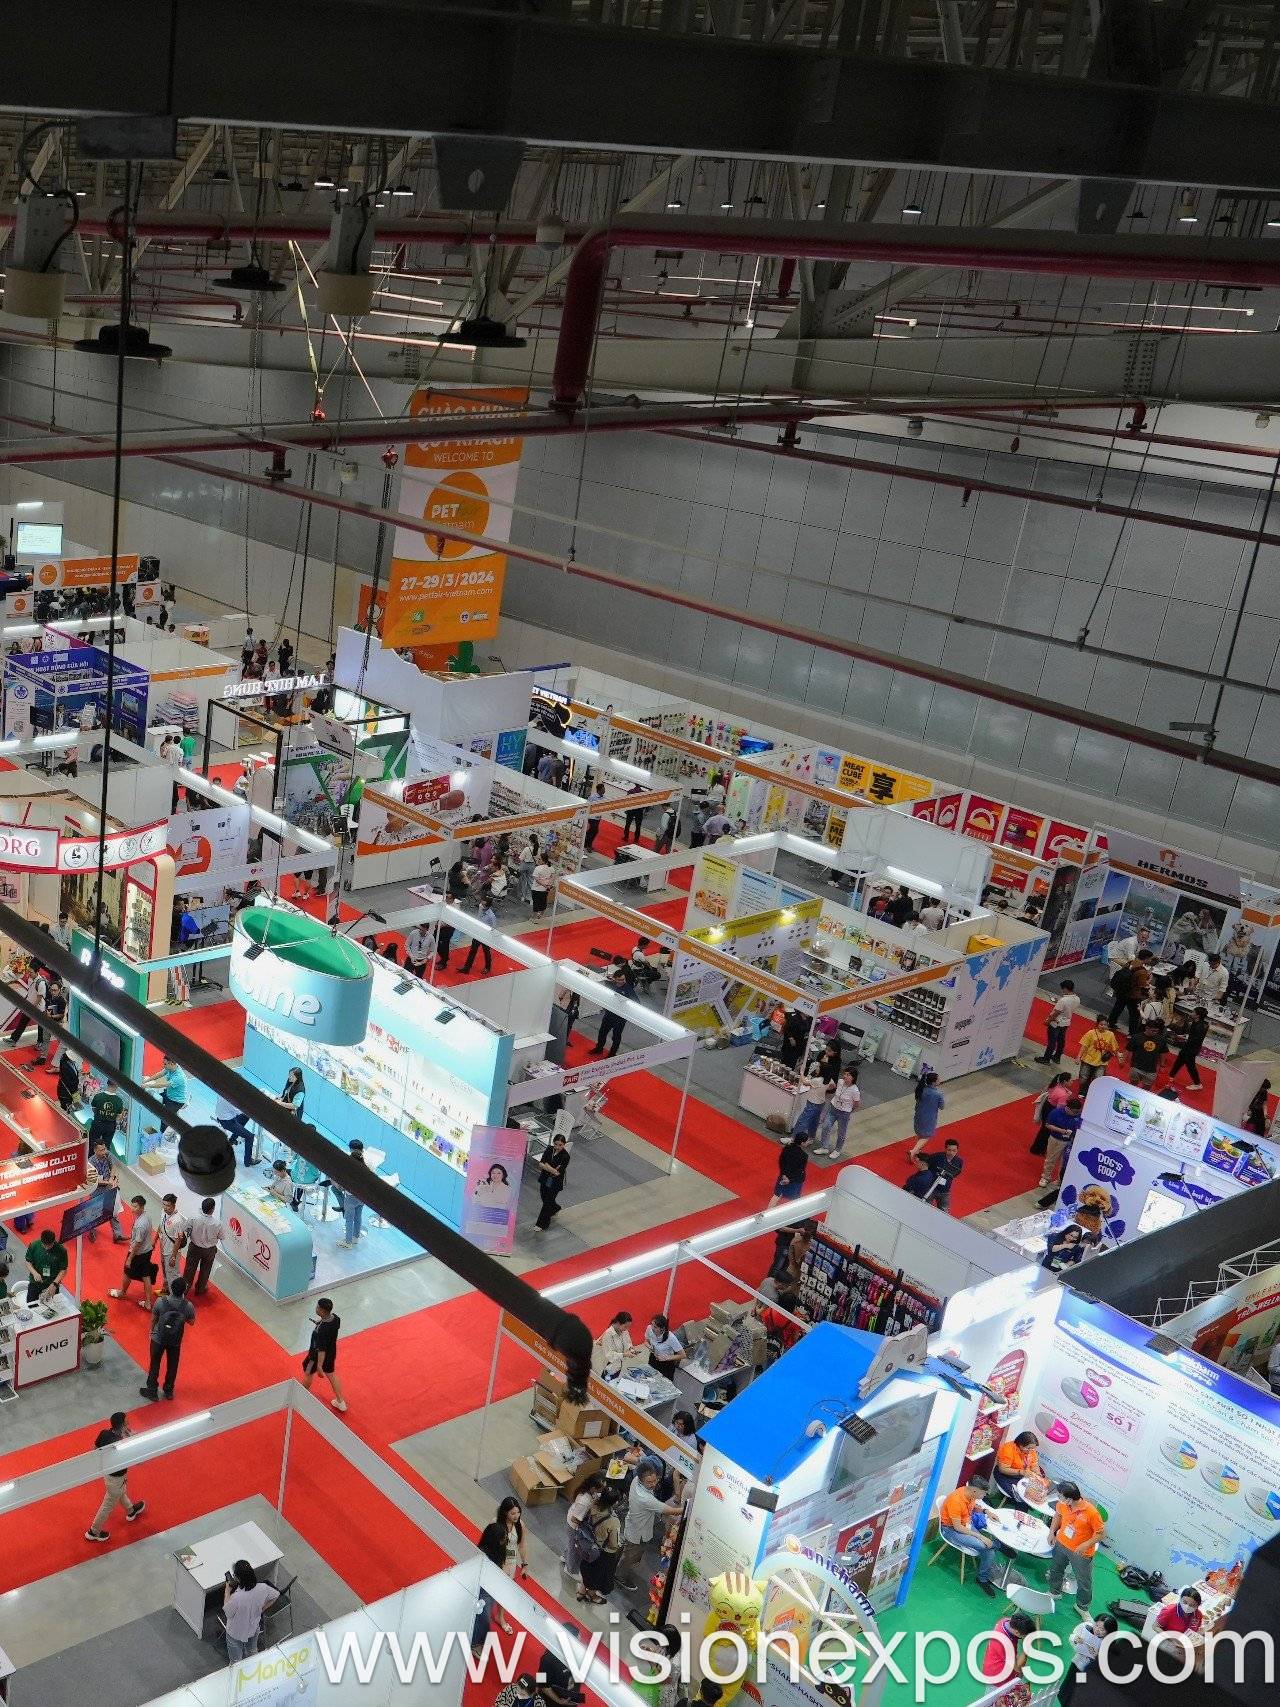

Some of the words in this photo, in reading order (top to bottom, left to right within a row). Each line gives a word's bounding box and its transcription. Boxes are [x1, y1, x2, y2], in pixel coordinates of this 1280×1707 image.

[433, 452, 479, 464] WELCOME
[482, 451, 494, 461] TO
[431, 503, 460, 519] PET
[400, 570, 496, 591] 27-29/3/2024
[842, 767, 863, 780] CUBE
[843, 760, 866, 773] MEAT
[1137, 859, 1209, 888] HERMOS
[1097, 1152, 1124, 1172] DOG'S
[52, 1164, 76, 1177] LIMITED
[1097, 1164, 1117, 1179] FOOD
[25, 1338, 71, 1360] VKING
[238, 1648, 311, 1693] Mango
